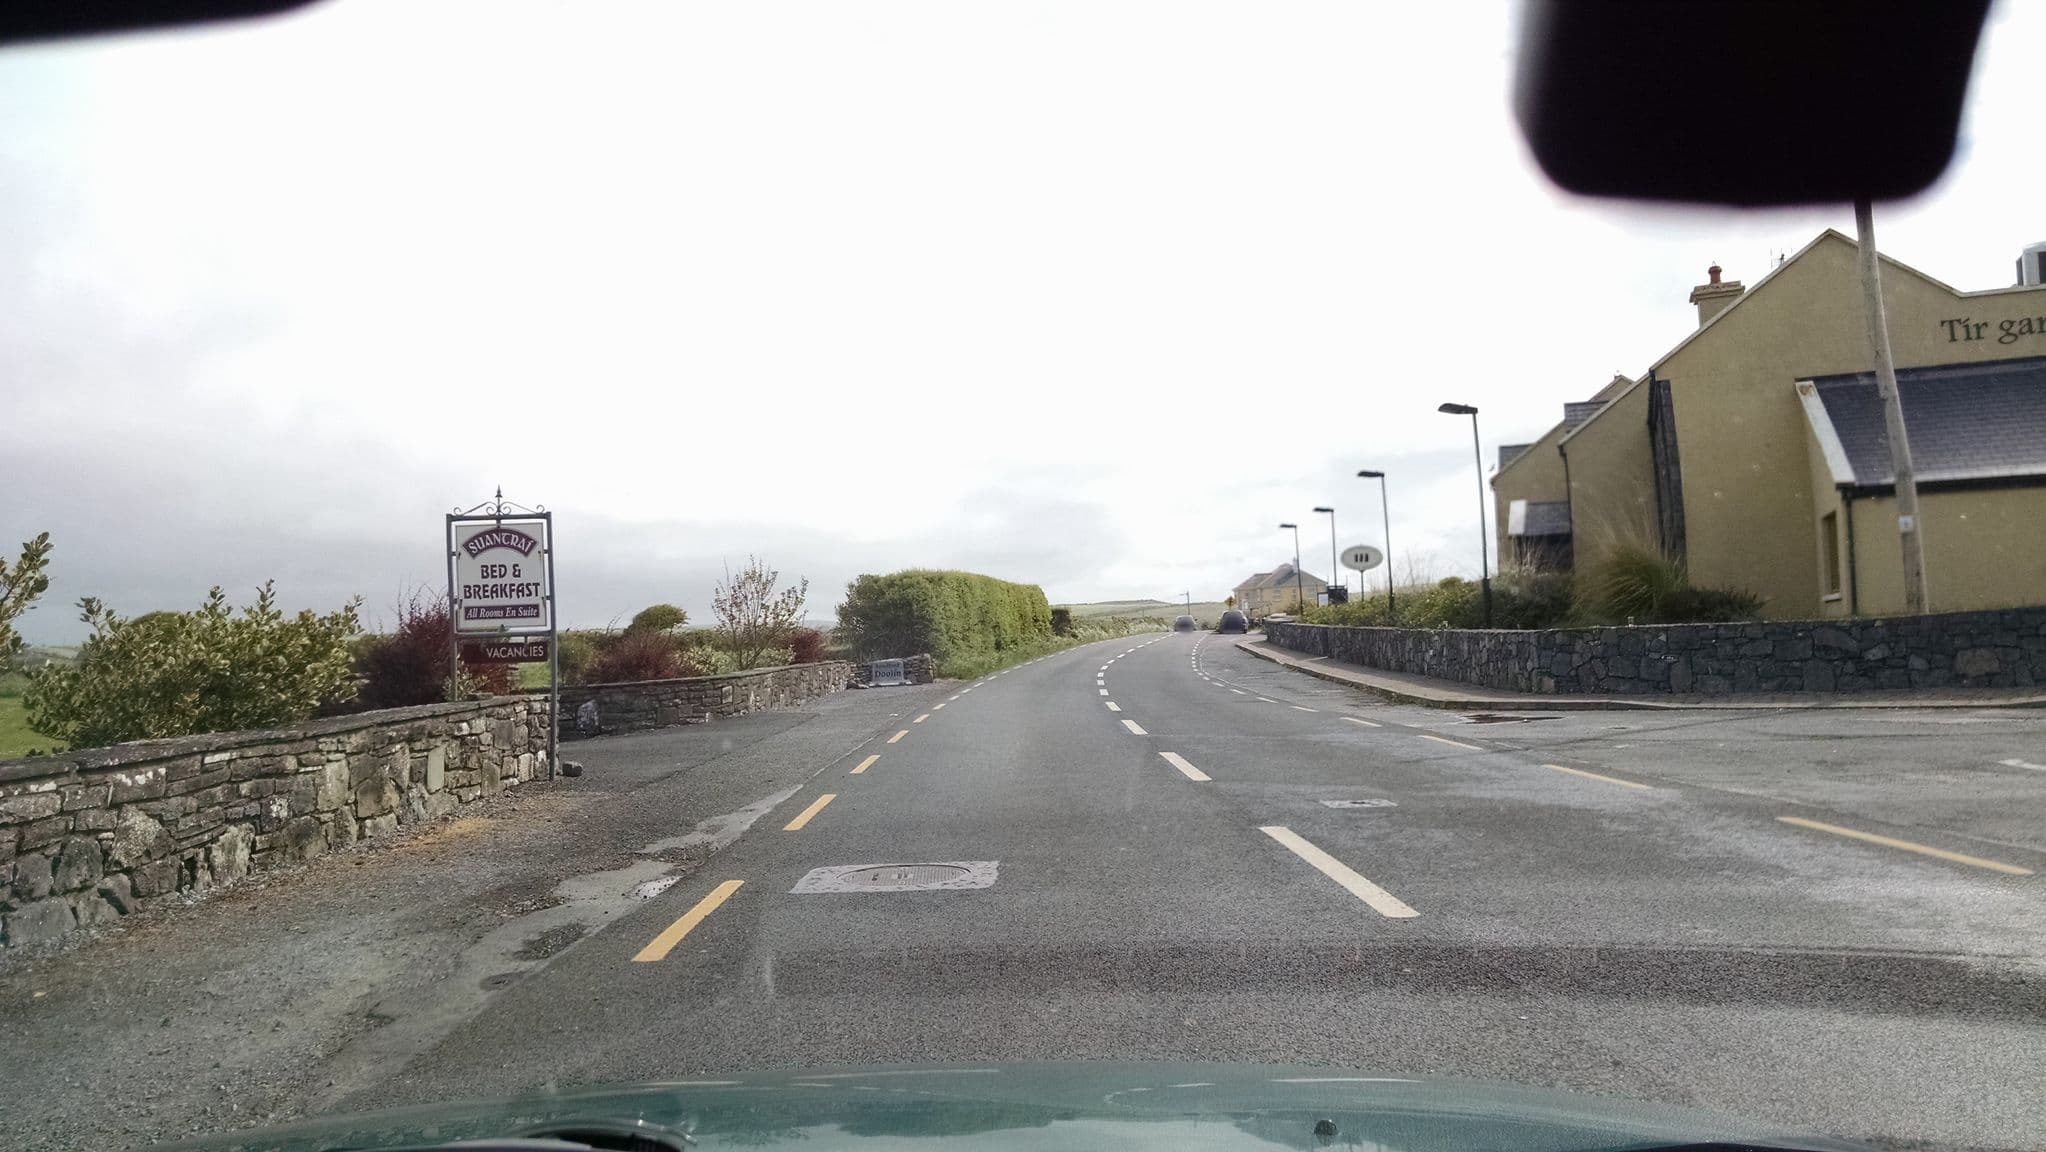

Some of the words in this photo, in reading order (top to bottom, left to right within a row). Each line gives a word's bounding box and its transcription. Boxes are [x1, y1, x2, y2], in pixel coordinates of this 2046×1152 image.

[1940, 317, 1988, 343] Tír
[480, 564, 508, 579] BED
[512, 563, 521, 579] &
[463, 582, 541, 600] BREAKFAST
[466, 608, 478, 619] All
[480, 607, 505, 618] Rooms
[506, 606, 517, 617] En
[518, 606, 538, 617] Suite
[486, 645, 544, 659] VACANCIES
